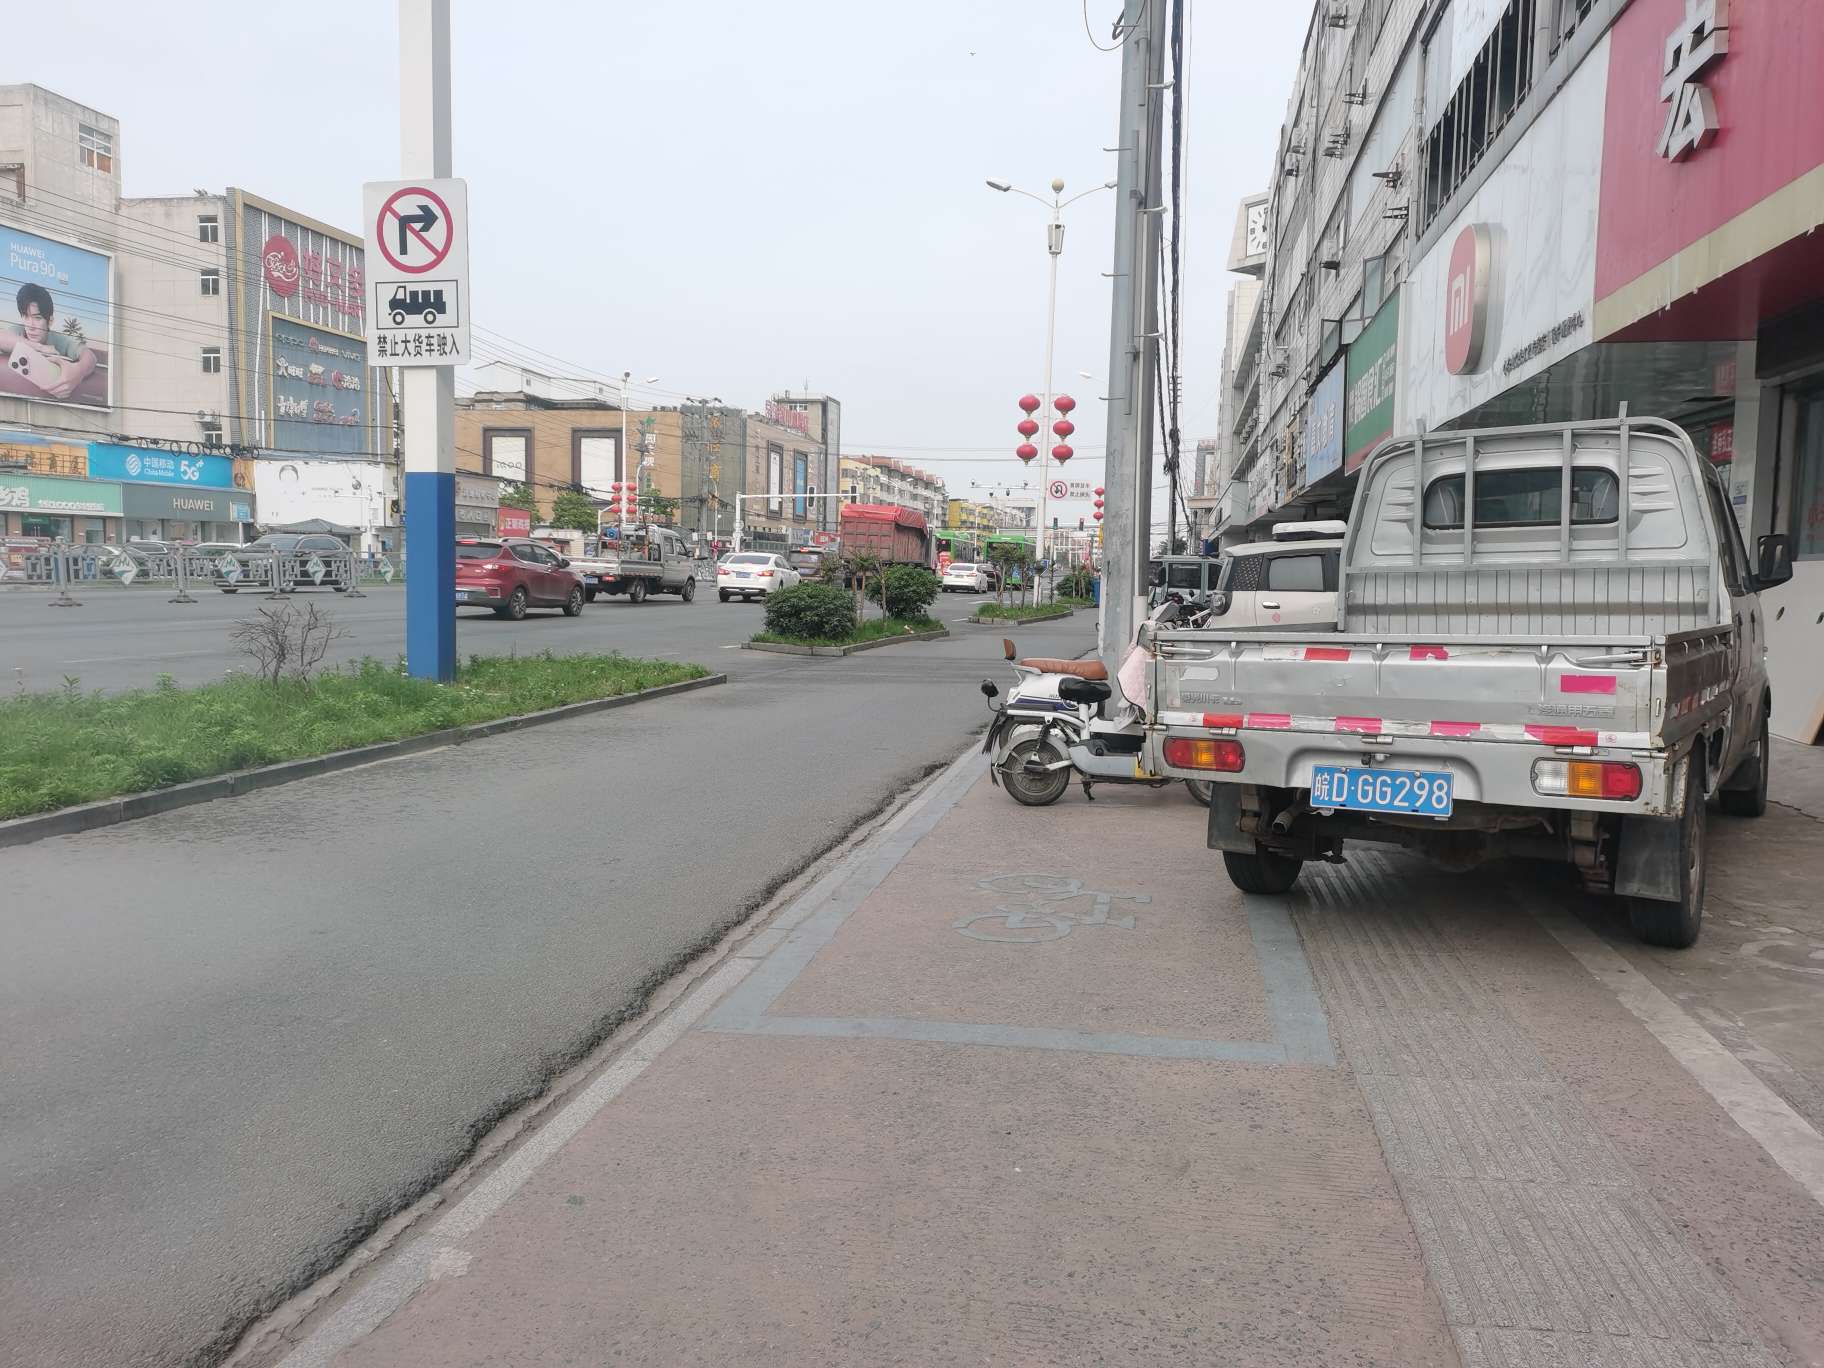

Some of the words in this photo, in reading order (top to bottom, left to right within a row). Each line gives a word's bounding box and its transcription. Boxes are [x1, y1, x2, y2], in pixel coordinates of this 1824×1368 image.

[10, 241, 46, 259] HUAWEI
[376, 333, 460, 358] 禁止大货车驶入
[173, 498, 214, 511] HUAWEI
[1314, 771, 1449, 810] 皖D·GG298
